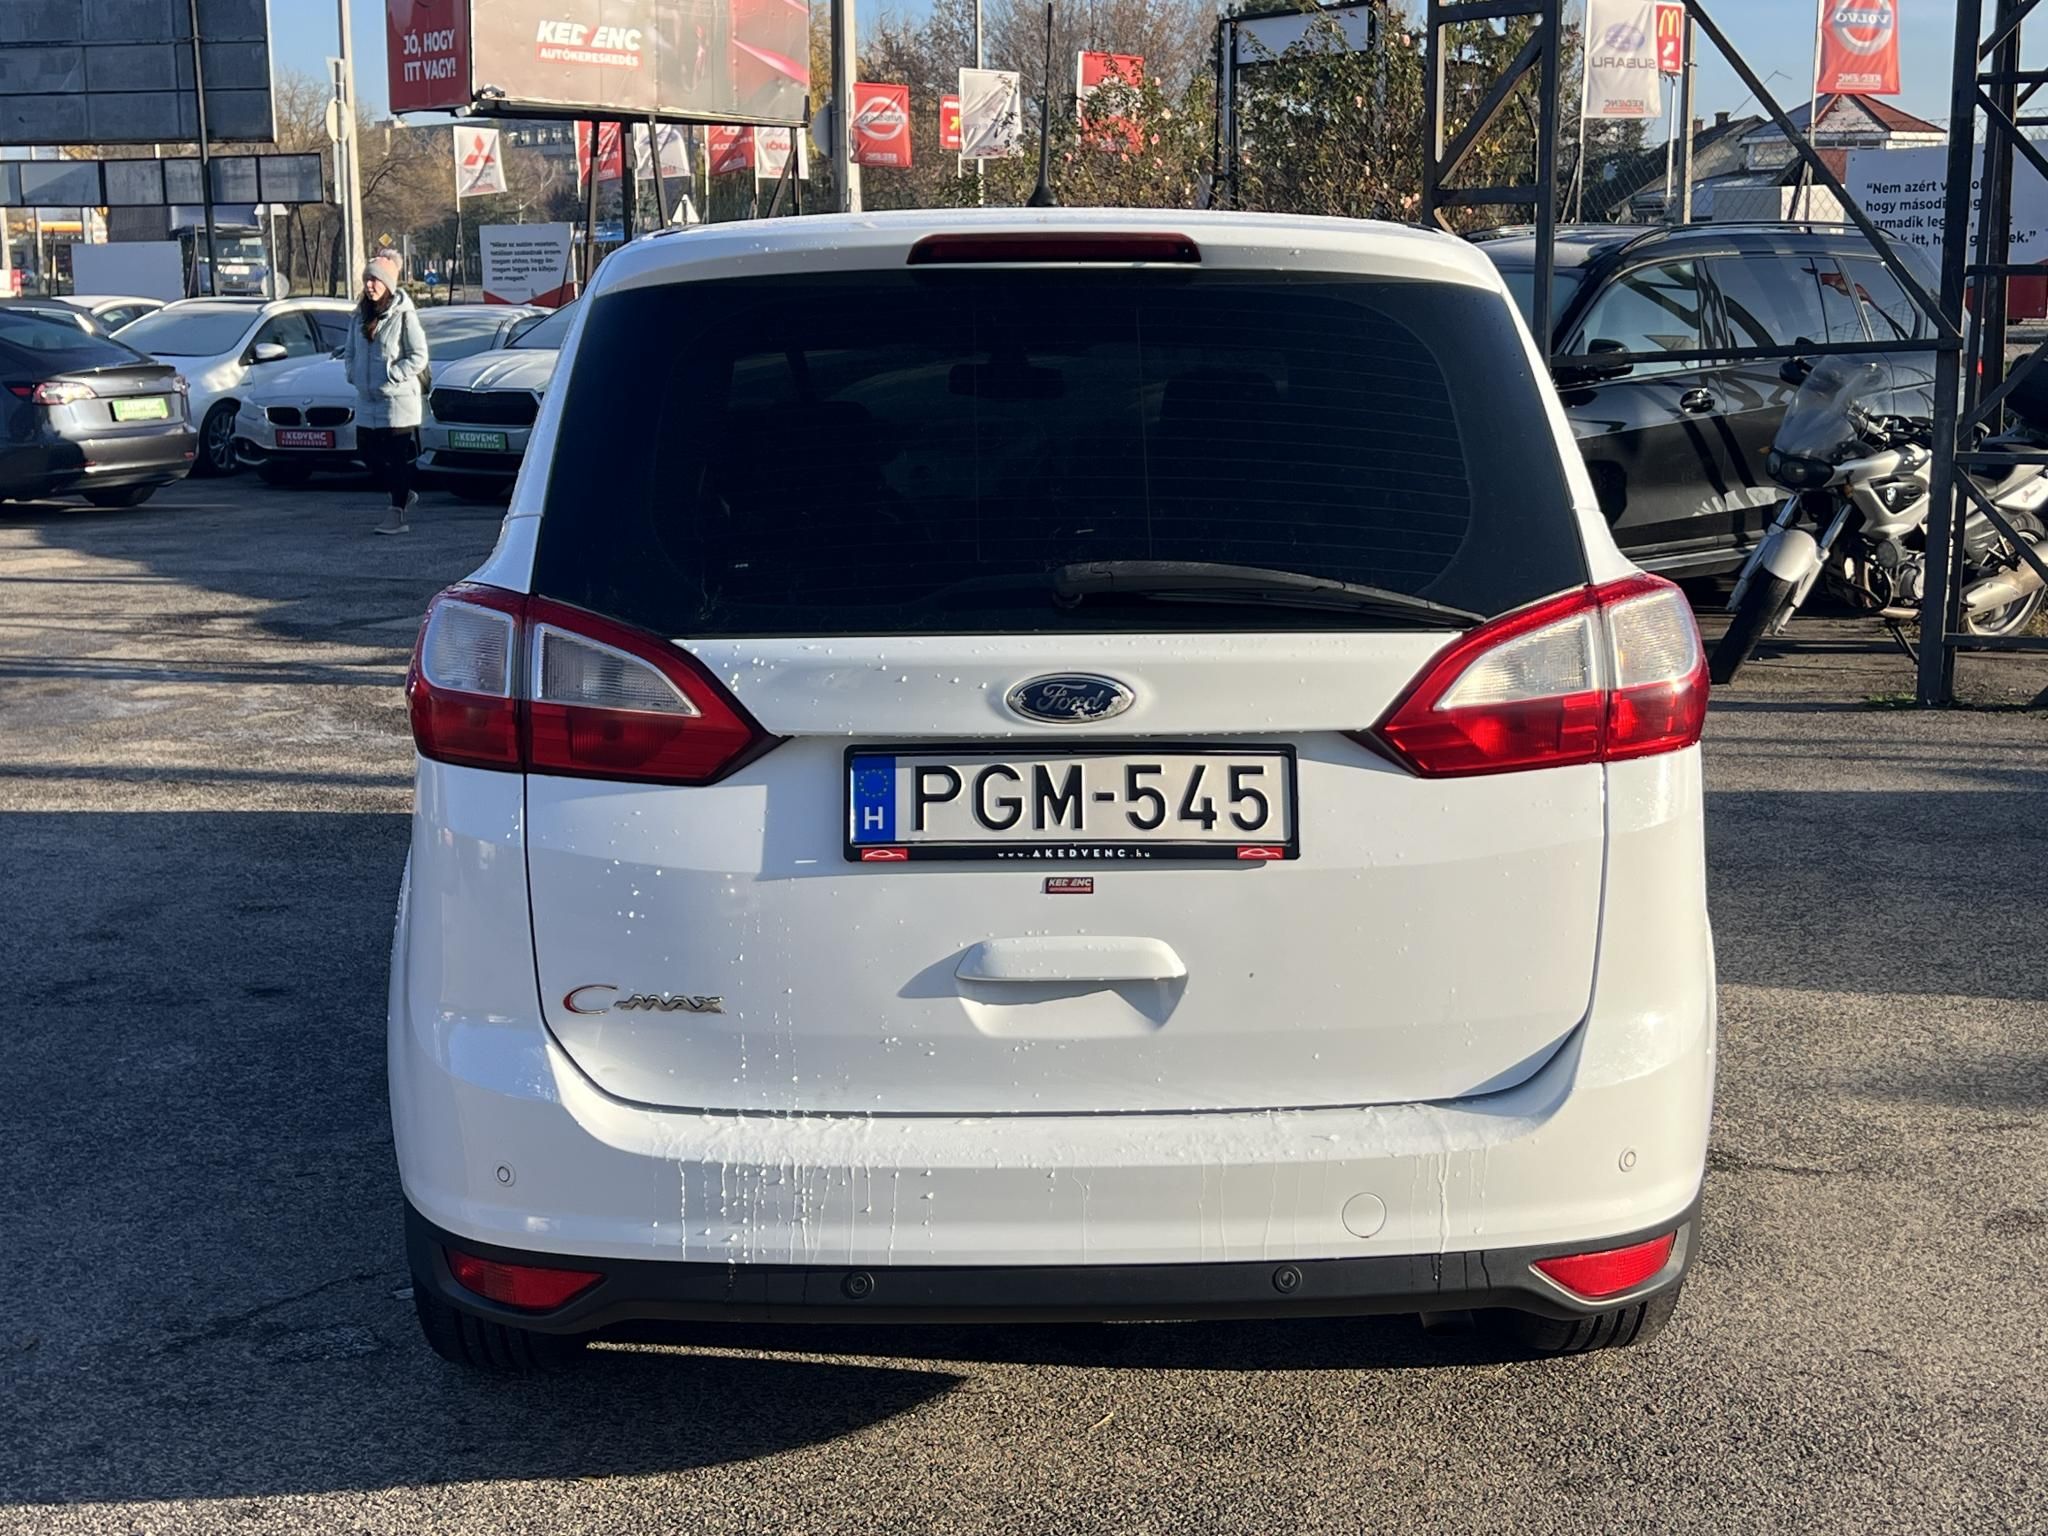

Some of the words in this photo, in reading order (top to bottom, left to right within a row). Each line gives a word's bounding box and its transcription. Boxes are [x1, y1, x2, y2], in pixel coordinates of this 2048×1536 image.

[403, 29, 421, 56] JÓ,
[423, 29, 455, 52] HOGY
[540, 47, 638, 67] AUTÓKERESKEDÉS
[404, 61, 421, 82] ITT
[423, 57, 456, 80] VAGY!
[1905, 180, 1937, 193] azért
[1866, 200, 1896, 214] hogy
[1900, 197, 1947, 211] másodi
[1873, 216, 1924, 229] armadik
[1912, 234, 1929, 247] itt,
[1036, 683, 1104, 711] Ford
[864, 806, 884, 831] H
[913, 764, 1270, 832] PGM-545
